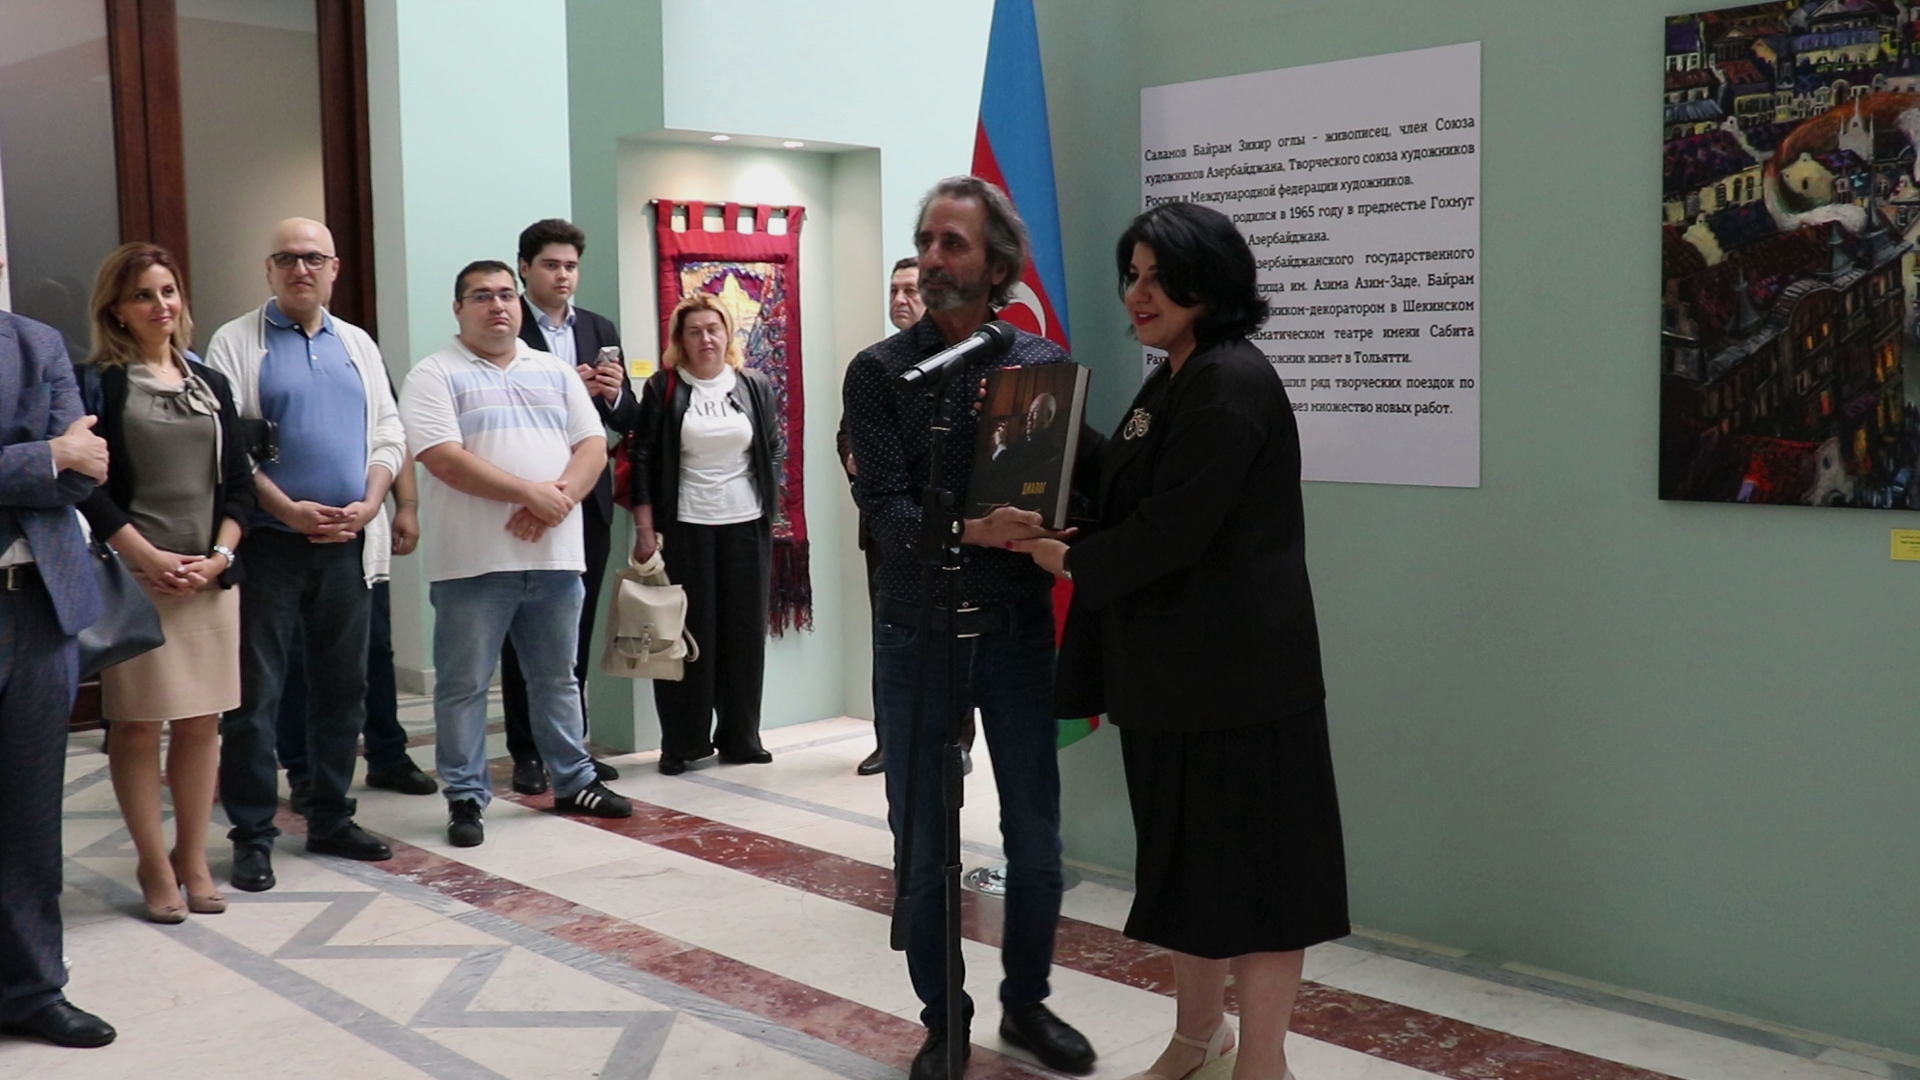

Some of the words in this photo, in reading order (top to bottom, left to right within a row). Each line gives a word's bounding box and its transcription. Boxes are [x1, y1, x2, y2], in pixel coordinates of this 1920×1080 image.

[1145, 149, 1187, 161] Саламов
[1193, 143, 1232, 157] Байрам
[1239, 139, 1272, 152] Зикир
[1278, 136, 1306, 147] оглы
[1399, 122, 1428, 135] член
[1435, 117, 1475, 131] Союза
[1145, 169, 1204, 186] художников
[1288, 155, 1361, 171] Творческого
[1363, 151, 1398, 163] союза
[1400, 143, 1475, 163] художников
[1190, 184, 1277, 203] Международной
[1278, 181, 1338, 198] федерации
[1340, 175, 1414, 193] художников.
[1233, 211, 1277, 223] родился
[1280, 210, 1287, 219] в
[1290, 205, 1315, 219] 1965
[1318, 205, 1344, 218] году
[1347, 205, 1354, 215] в
[1358, 199, 1427, 216] предместье
[1431, 196, 1475, 210] Гохмут
[1248, 231, 1330, 247] Азербайджана.
[1255, 255, 1354, 271] зербайджанского
[1365, 248, 1475, 266] государственного
[1291, 282, 1308, 291] им.
[1314, 278, 1349, 291] Азима
[1427, 272, 1475, 288] Байрам
[1269, 303, 1386, 317] ником-декоратором
[1391, 303, 1398, 313] в
[1403, 300, 1475, 312] Шекинском
[1334, 328, 1374, 341] театре
[1383, 328, 1420, 338] имени
[1429, 324, 1475, 337] Сабита
[1308, 354, 1342, 364] живет
[1345, 354, 1351, 363] в
[1354, 351, 1412, 364] Тольятти.
[1311, 377, 1331, 391] ряд
[1336, 377, 1402, 391] творческих
[1406, 377, 1455, 389] поездок
[1459, 378, 1475, 388] по
[1311, 402, 1373, 413] множество
[1375, 402, 1412, 414] новых
[1414, 400, 1453, 416] работ.
